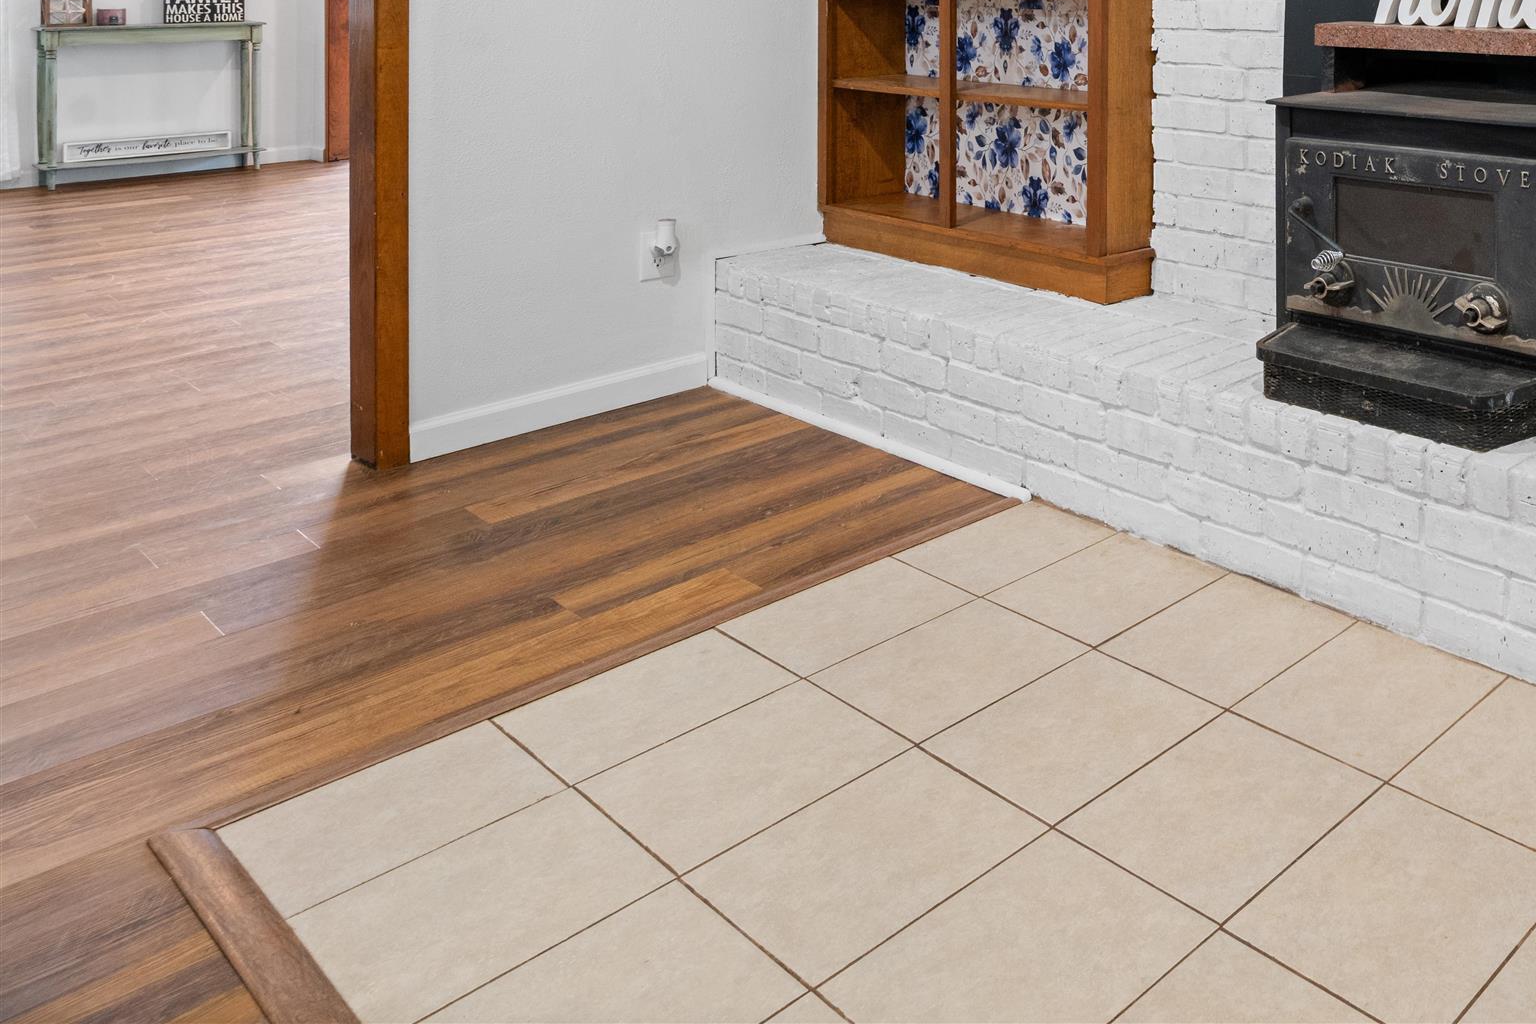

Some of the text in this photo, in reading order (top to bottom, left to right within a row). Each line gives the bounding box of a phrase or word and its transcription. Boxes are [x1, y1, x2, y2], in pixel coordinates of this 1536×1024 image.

[166, 2, 244, 14] MAKES THIS
[166, 12, 244, 23] HOUSE A HOME
[1299, 148, 1532, 189] KODIAK STOVE
